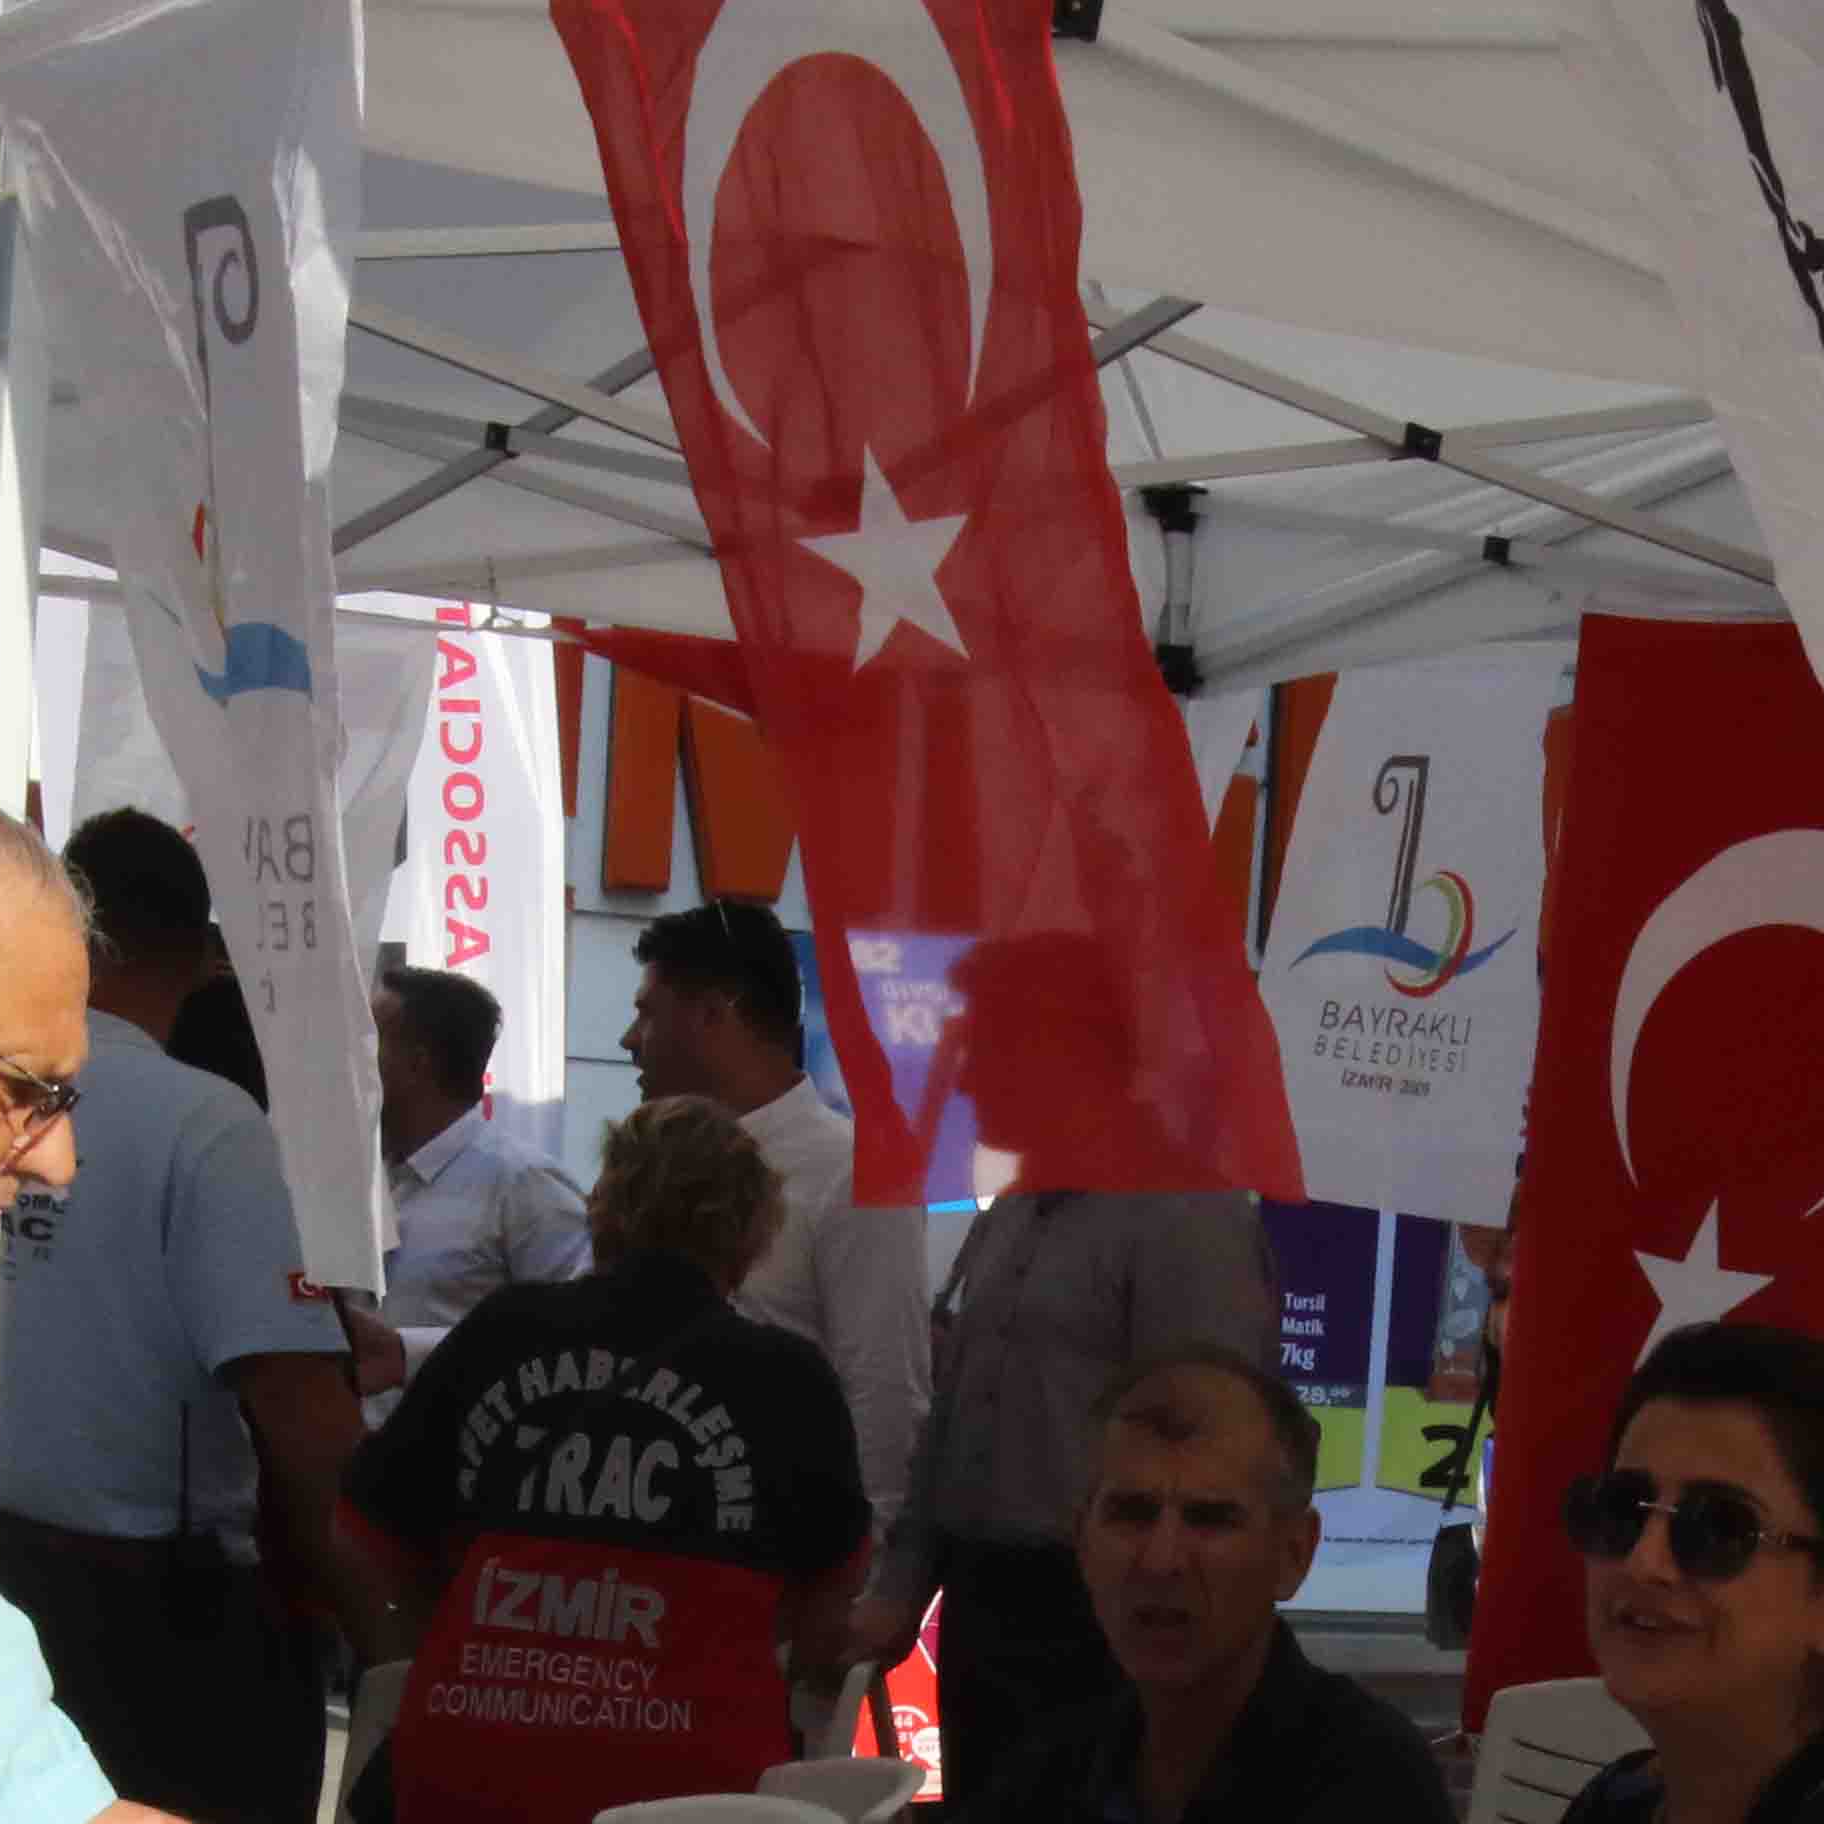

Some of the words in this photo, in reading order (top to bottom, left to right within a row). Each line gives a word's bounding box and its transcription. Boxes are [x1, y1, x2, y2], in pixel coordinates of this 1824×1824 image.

[1319, 999, 1472, 1046] BAYRAKLI
[1281, 1316, 1325, 1338] Matik
[1283, 1292, 1326, 1313] Tursil
[472, 1555, 668, 1649] İZMİR
[459, 1642, 657, 1693] EMERGENCY
[426, 1681, 695, 1734] COMMUNICATION
